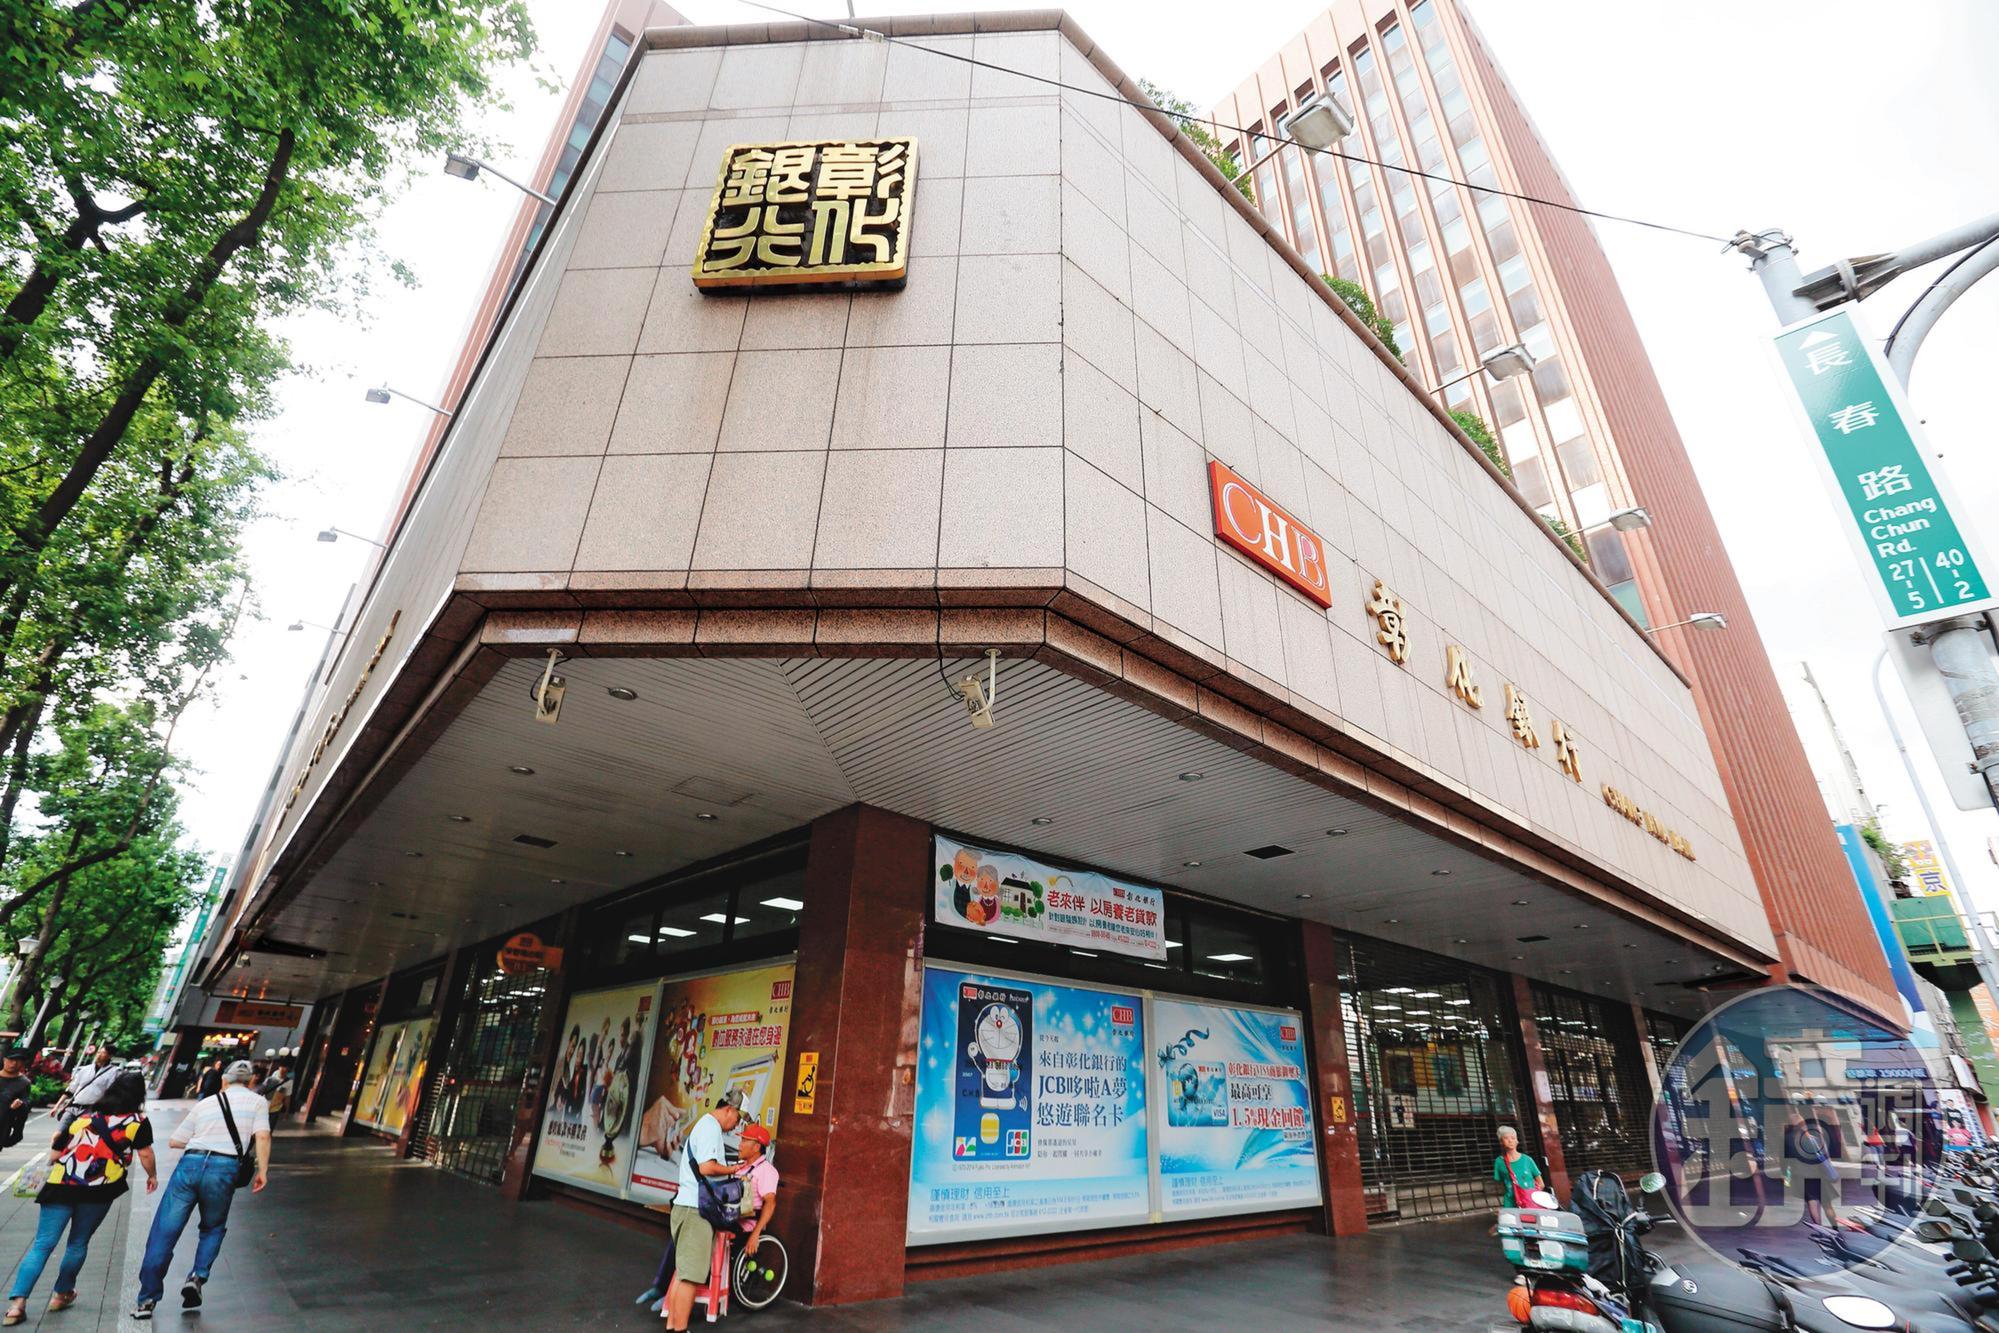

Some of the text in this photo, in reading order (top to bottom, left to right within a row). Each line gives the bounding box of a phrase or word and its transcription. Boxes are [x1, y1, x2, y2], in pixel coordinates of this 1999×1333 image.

[1805, 341, 1914, 502] 長春路
[1864, 497, 1938, 526] Chang
[1222, 481, 1327, 590] CHB
[1871, 518, 1931, 541] Chun
[1877, 537, 1918, 559] Rd.
[1936, 548, 1965, 570] 40
[1888, 559, 1915, 582] 27
[1907, 590, 1926, 610] 5
[1954, 580, 1975, 600] 2
[1047, 890, 1158, 927] 老來伴 以房養老貸款
[772, 983, 791, 999] CHB
[1112, 1008, 1134, 1024] CHB
[1038, 1050, 1127, 1072] 來自彰化銀行的
[1038, 1075, 1128, 1100] JCB哆啦A夢
[1230, 1082, 1272, 1102] 最高可享
[1036, 1102, 1125, 1128] 悠遊聯名卡
[1213, 1110, 1226, 1118] VISA
[930, 1186, 1011, 1201] 謹慎理財 信用至上
